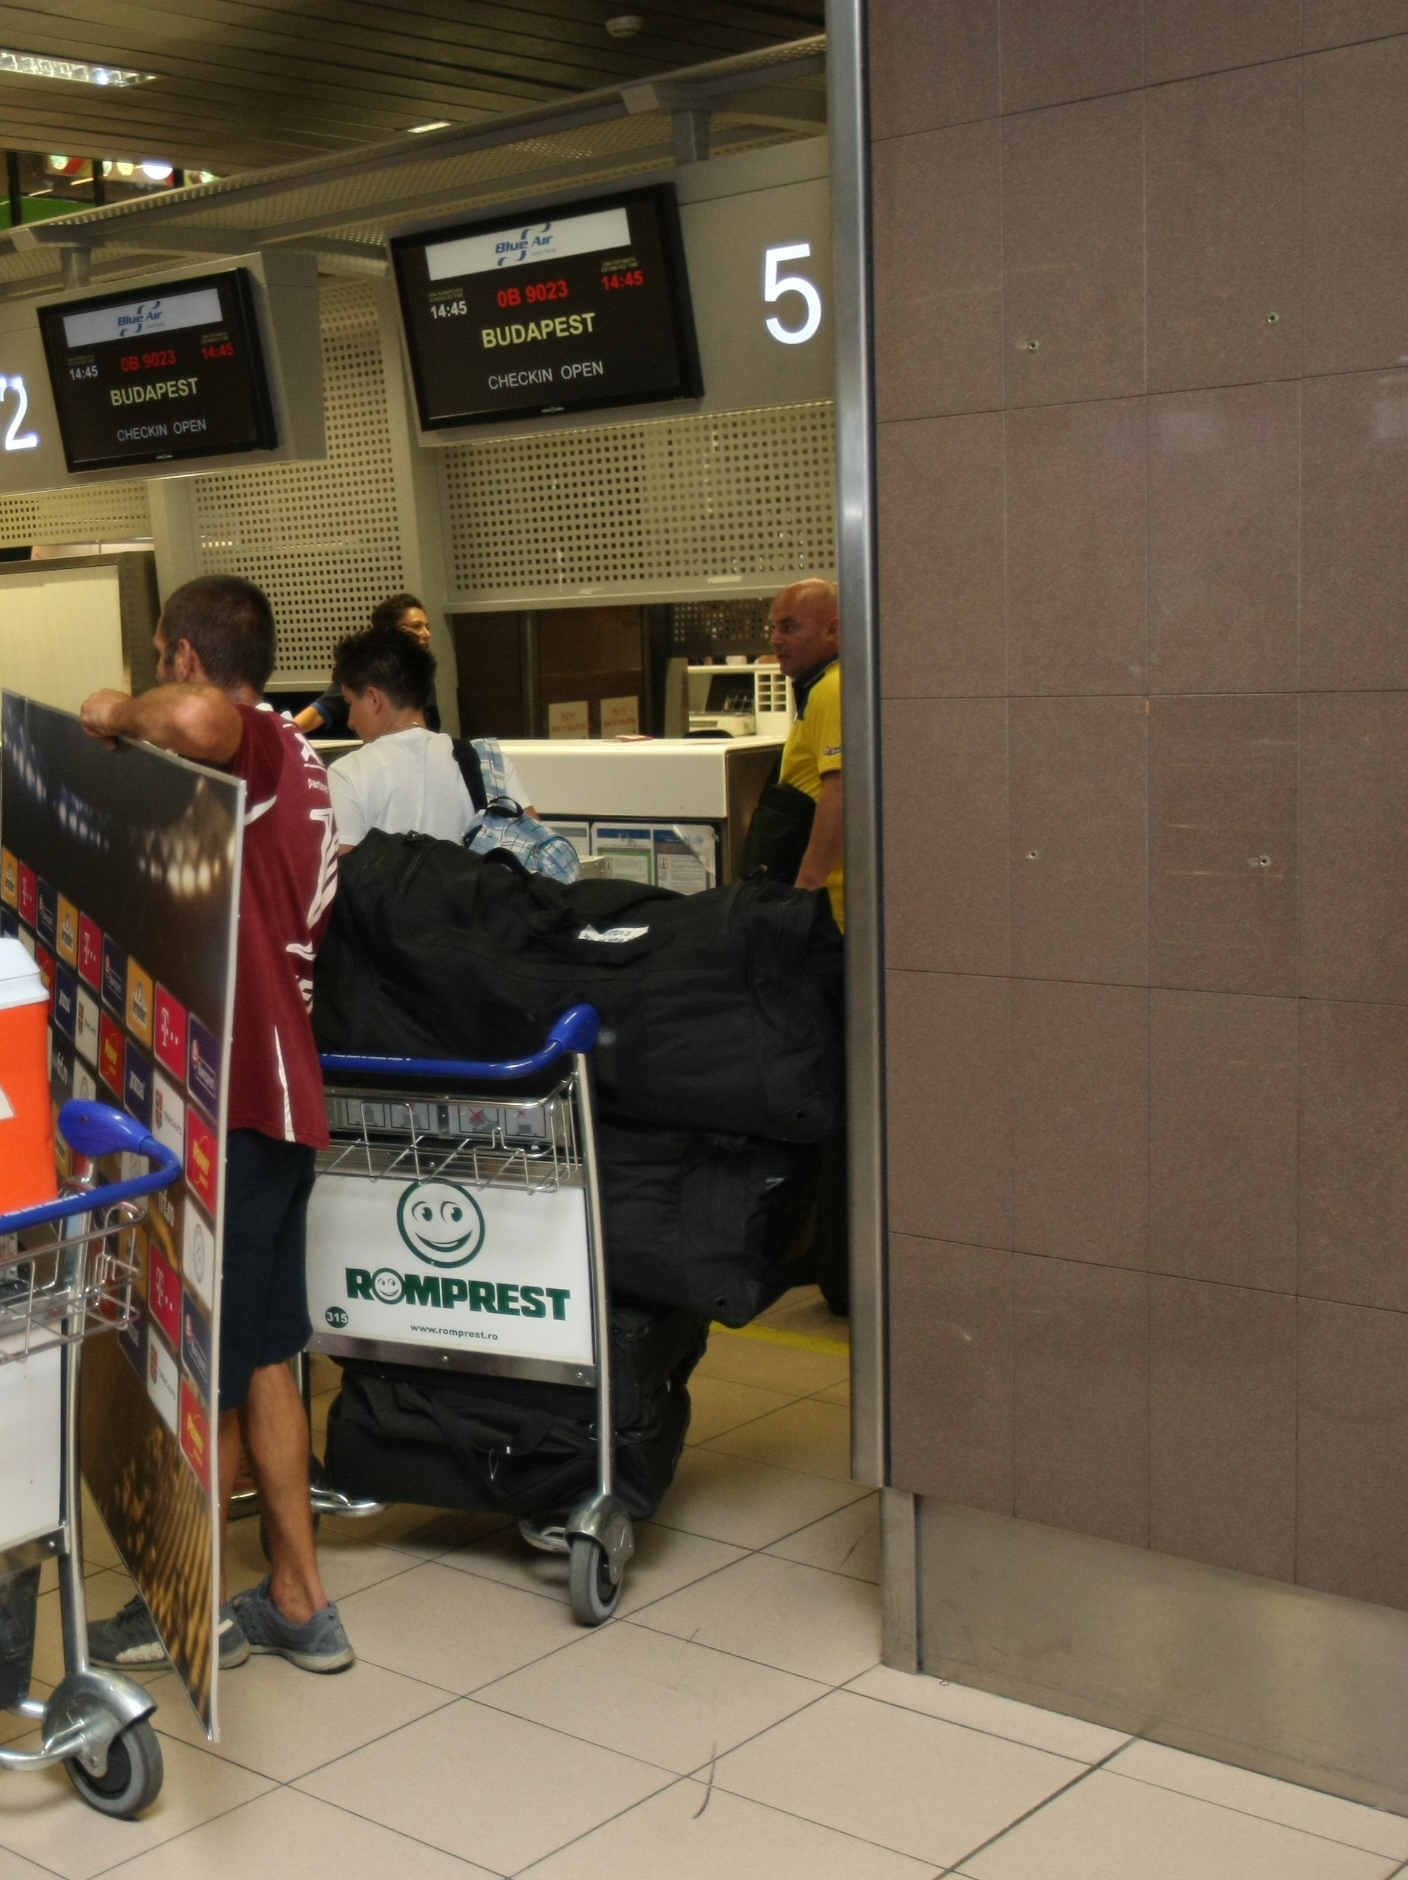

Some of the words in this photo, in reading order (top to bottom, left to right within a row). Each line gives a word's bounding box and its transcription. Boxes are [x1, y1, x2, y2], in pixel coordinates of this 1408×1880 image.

[495, 238, 528, 254] Blue
[531, 234, 553, 247] Air
[430, 300, 468, 320] 14:45
[525, 280, 569, 304] 9023
[601, 270, 644, 290] 14:45
[117, 313, 143, 327] Blue
[145, 310, 163, 321] Air
[481, 312, 596, 348] BUDAPEST
[69, 365, 98, 380] 14:45
[143, 349, 177, 369] 9023
[200, 342, 235, 359] 14:45
[488, 367, 553, 390] CHECKIN
[560, 361, 604, 380] OPEN
[110, 377, 199, 406] BUDAPEST
[117, 423, 168, 442] CHECKIN
[173, 419, 207, 434] OPEN
[344, 1266, 571, 1321] ROMPREST
[326, 1311, 348, 1324] 315
[410, 1323, 499, 1341] www.romprest.ro
